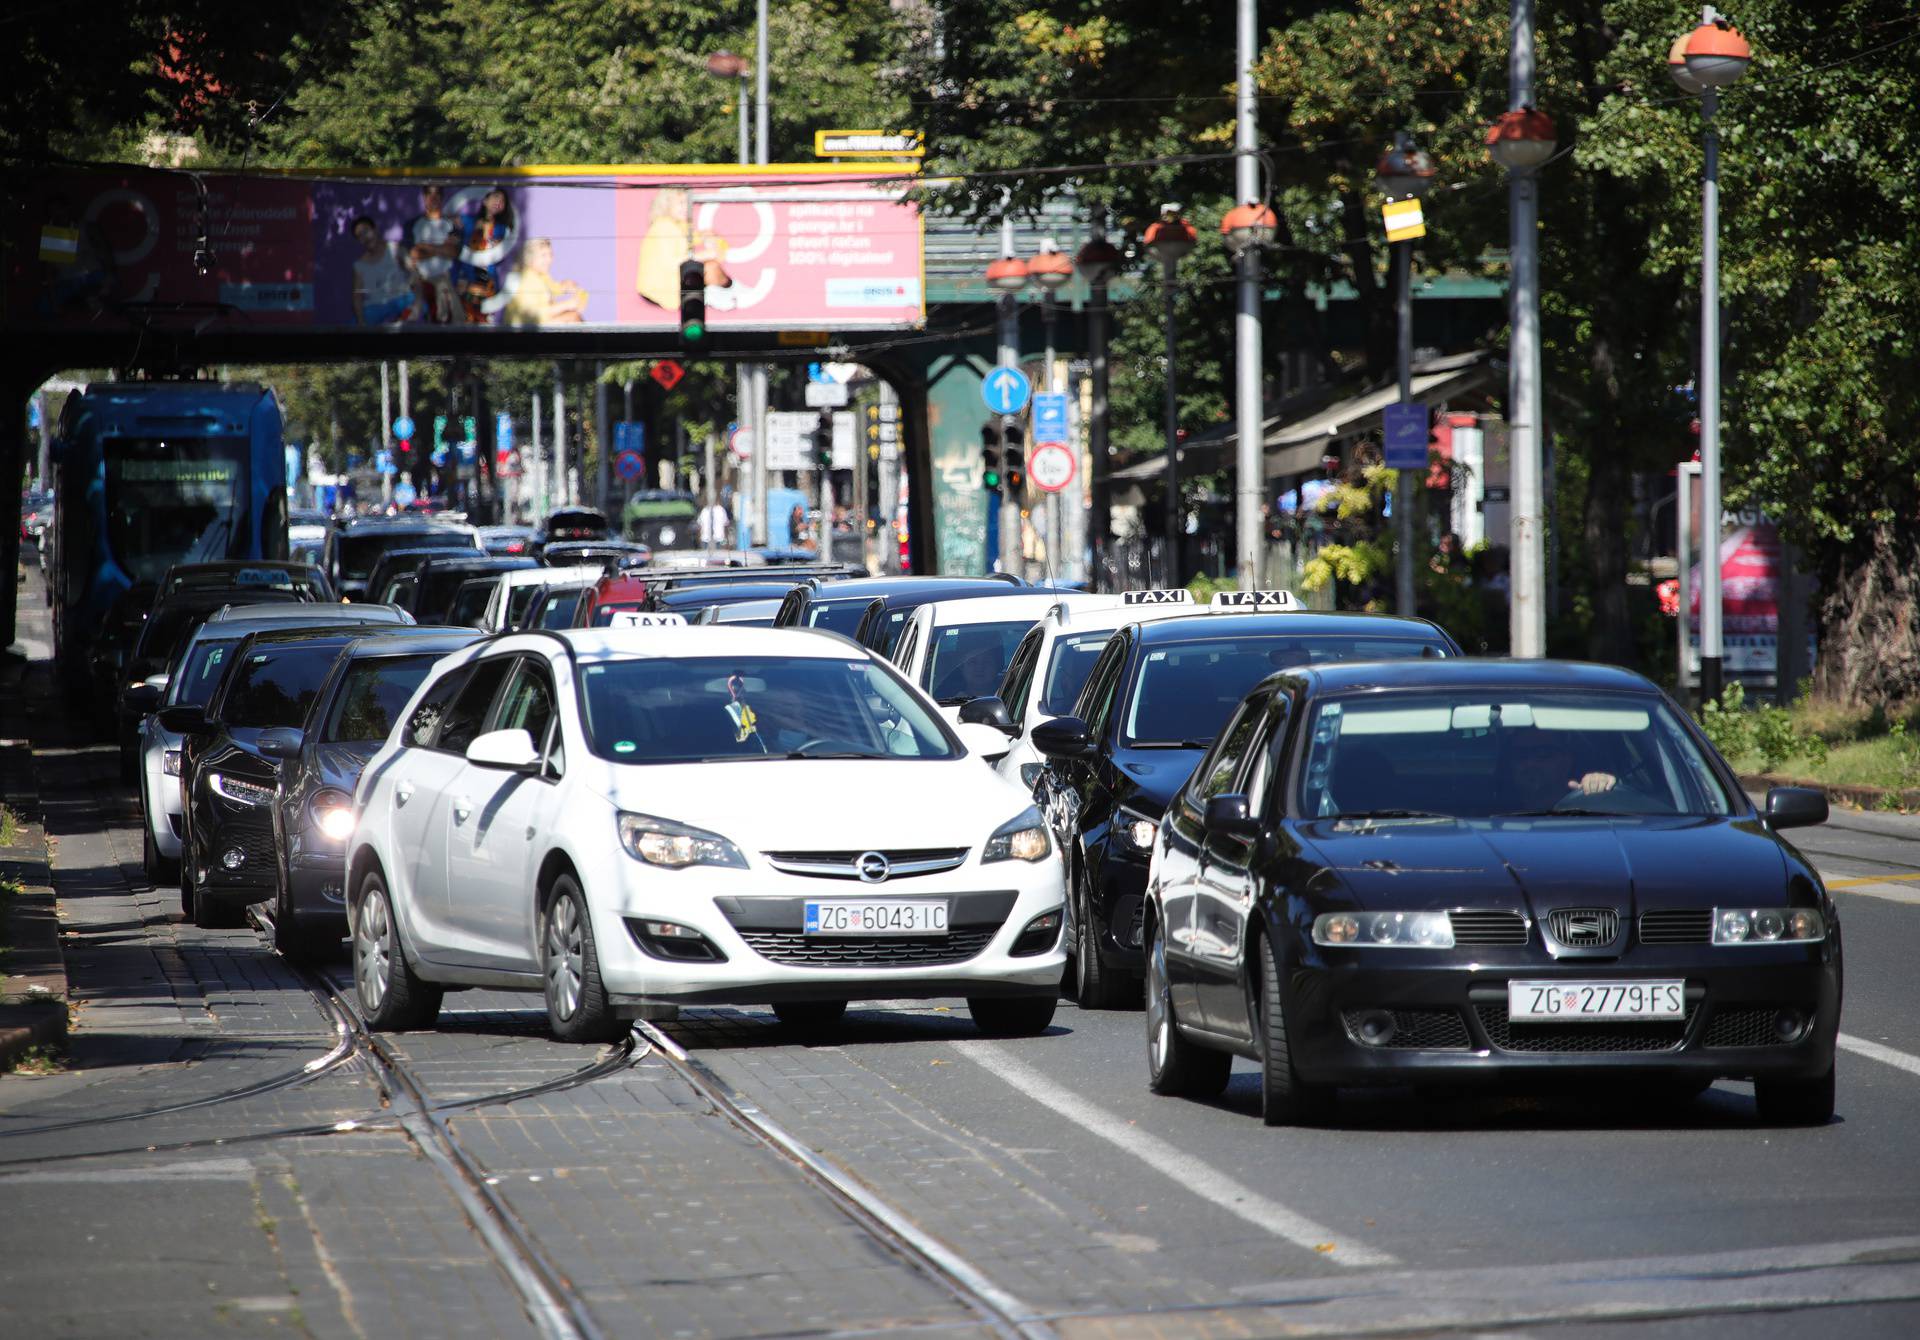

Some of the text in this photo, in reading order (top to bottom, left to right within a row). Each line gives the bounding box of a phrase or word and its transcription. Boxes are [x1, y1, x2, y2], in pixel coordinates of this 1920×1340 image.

[1126, 591, 1183, 604] TAXI
[1221, 591, 1287, 605] TAXI
[625, 616, 677, 627] TAXI
[822, 907, 848, 930] ZG
[1530, 987, 1561, 1014] ZG
